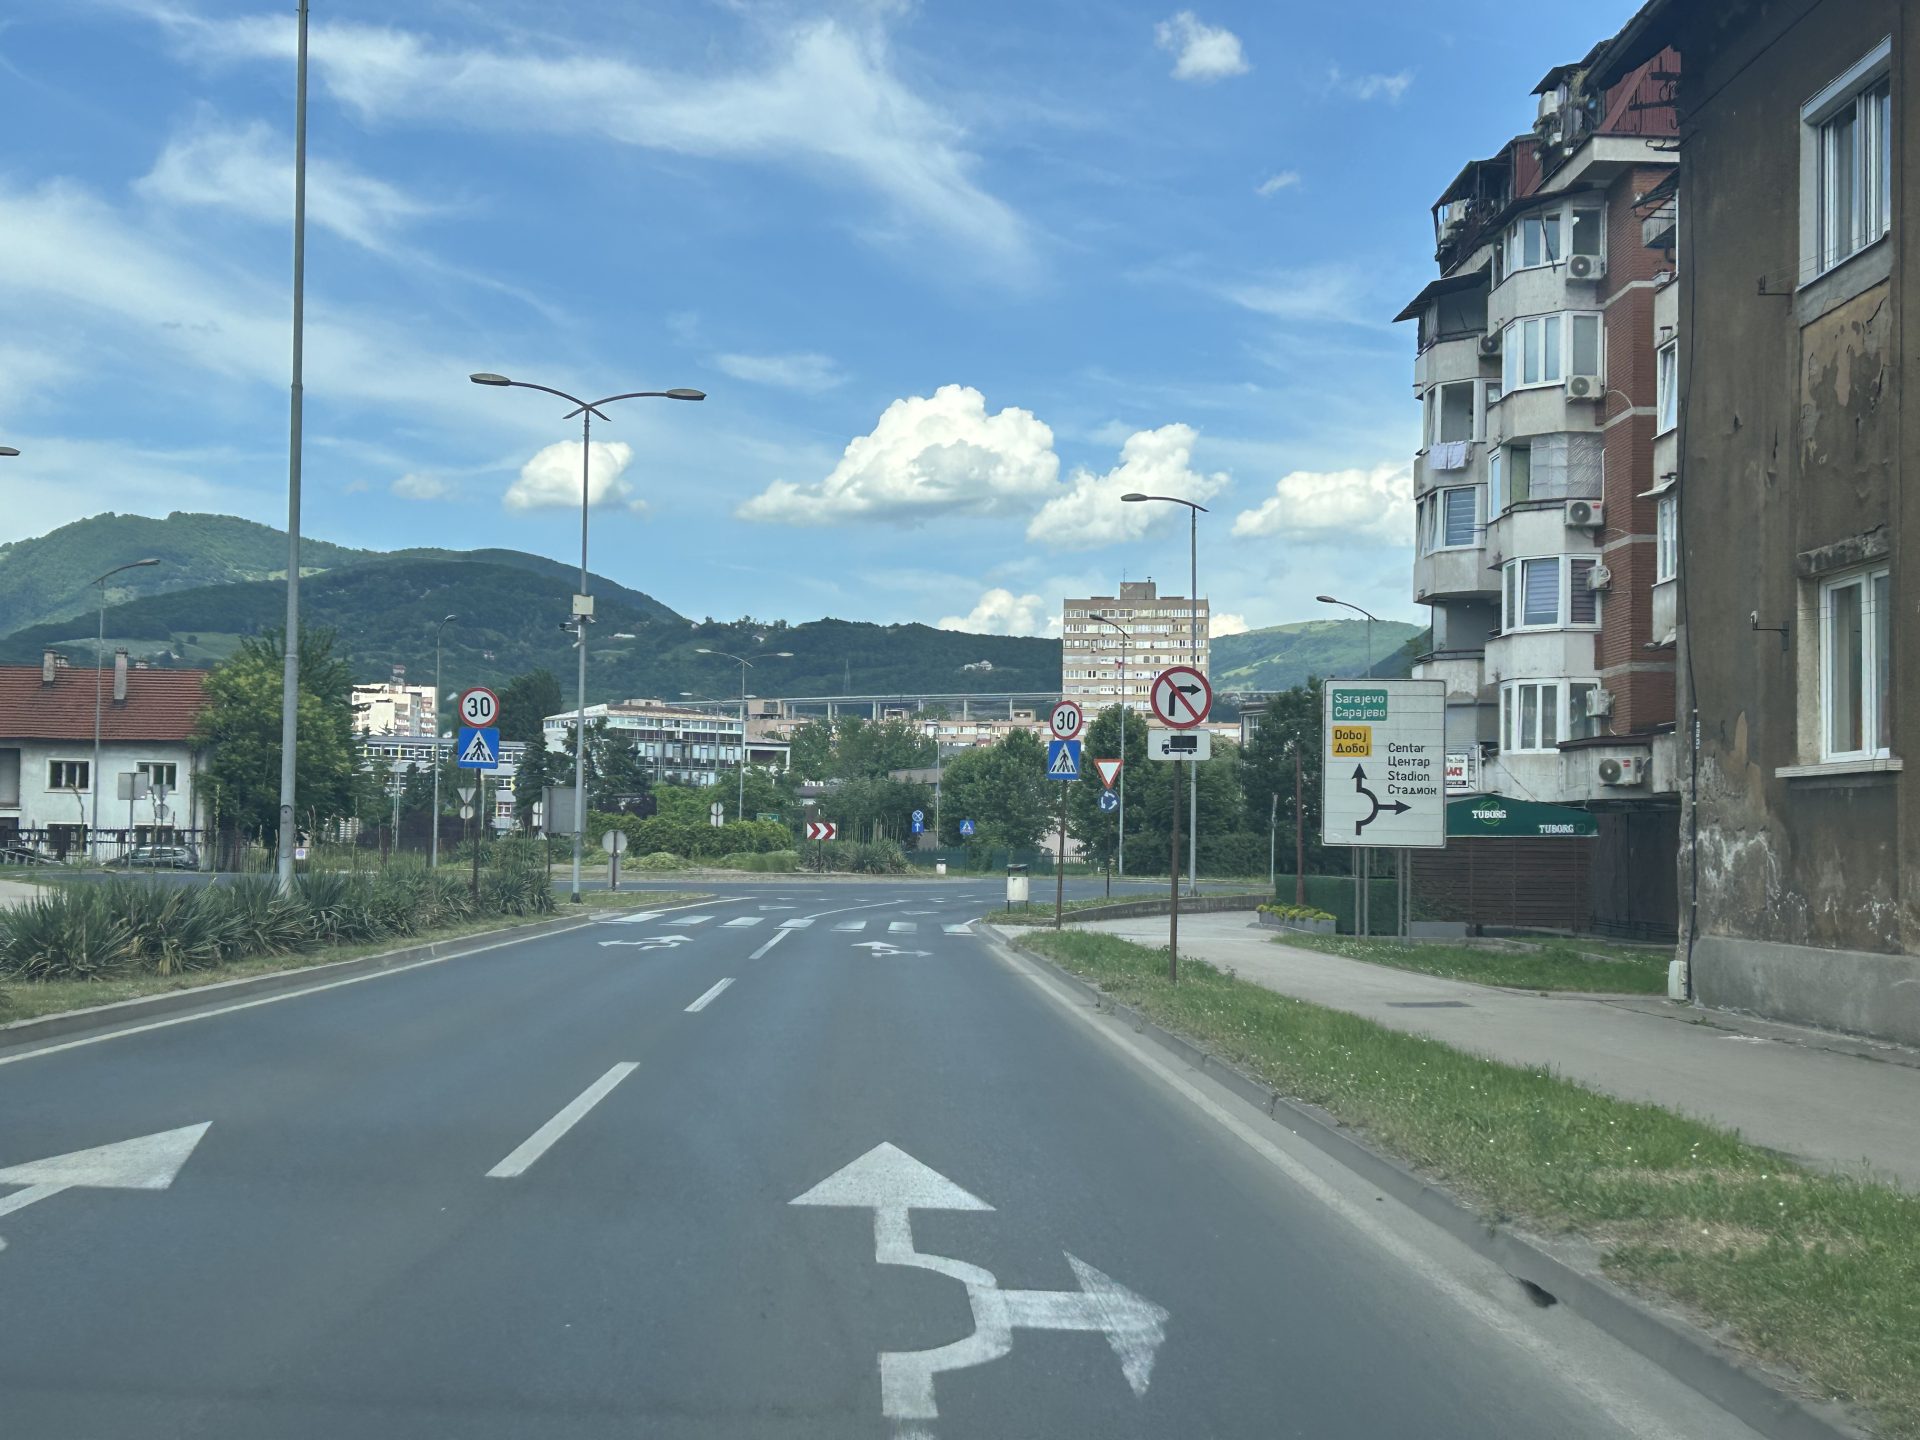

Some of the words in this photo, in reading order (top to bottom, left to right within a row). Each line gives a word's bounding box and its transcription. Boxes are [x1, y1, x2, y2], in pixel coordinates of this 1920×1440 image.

[1335, 693, 1385, 705] Sarajevo
[467, 697, 490, 717] 30
[1335, 707, 1385, 719] Сарајево
[1057, 711, 1076, 730] 30
[1335, 730, 1367, 742] Doboj
[1335, 743, 1369, 756] Добој
[1388, 743, 1425, 753] Centar
[1388, 756, 1430, 768] Центар
[1388, 770, 1430, 781] Stadion
[1387, 784, 1436, 795] Стадион
[1472, 810, 1506, 819] TUBORG
[1539, 824, 1574, 833] TUBORG
